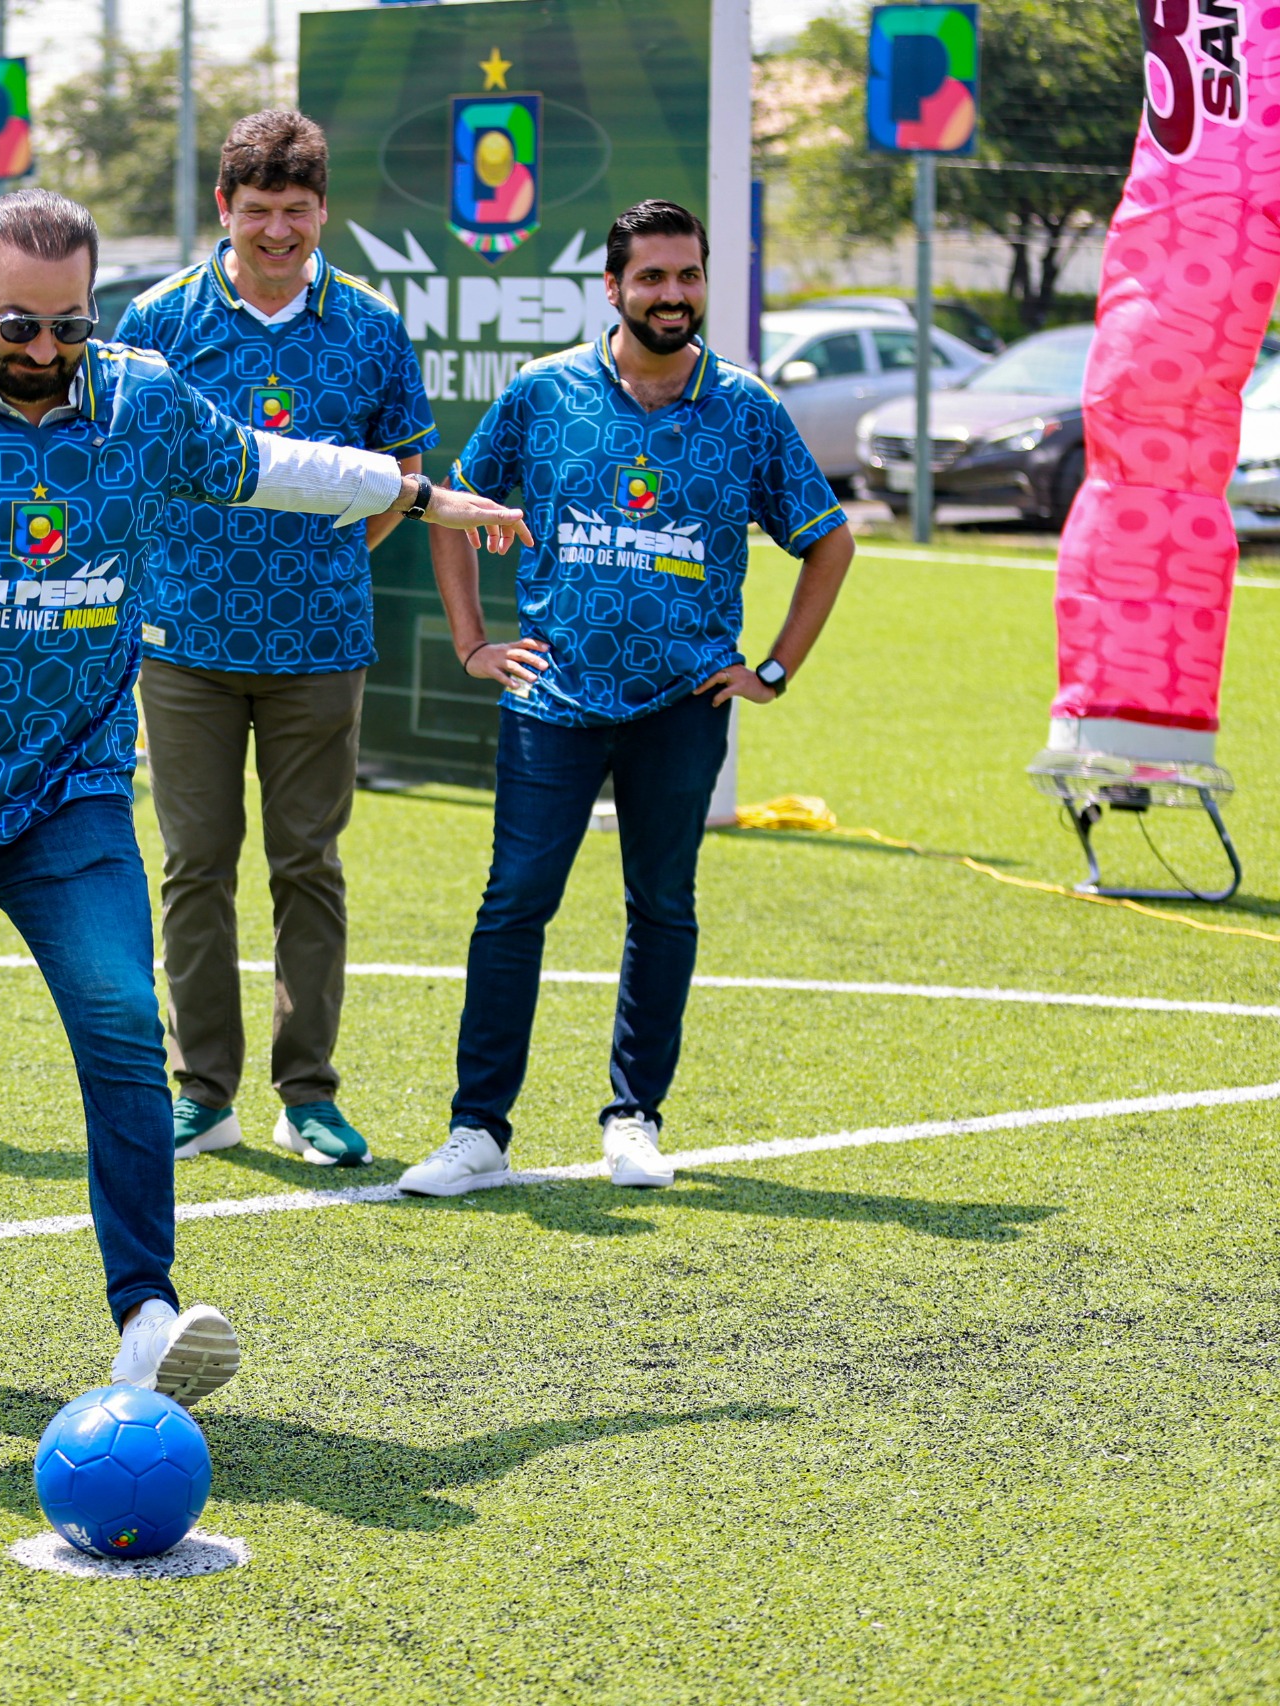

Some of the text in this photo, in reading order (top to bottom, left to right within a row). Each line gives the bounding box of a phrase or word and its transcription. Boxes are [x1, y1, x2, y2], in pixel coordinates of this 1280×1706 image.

[423, 349, 459, 401] DE
[557, 523, 705, 561] SAN PEDRO
[559, 546, 706, 581] CIUDAD DE NIVEL MUNDIAL
[14, 577, 125, 607] PEDRO
[15, 609, 60, 631] NIVEL
[63, 606, 118, 630] MUNDIAL
